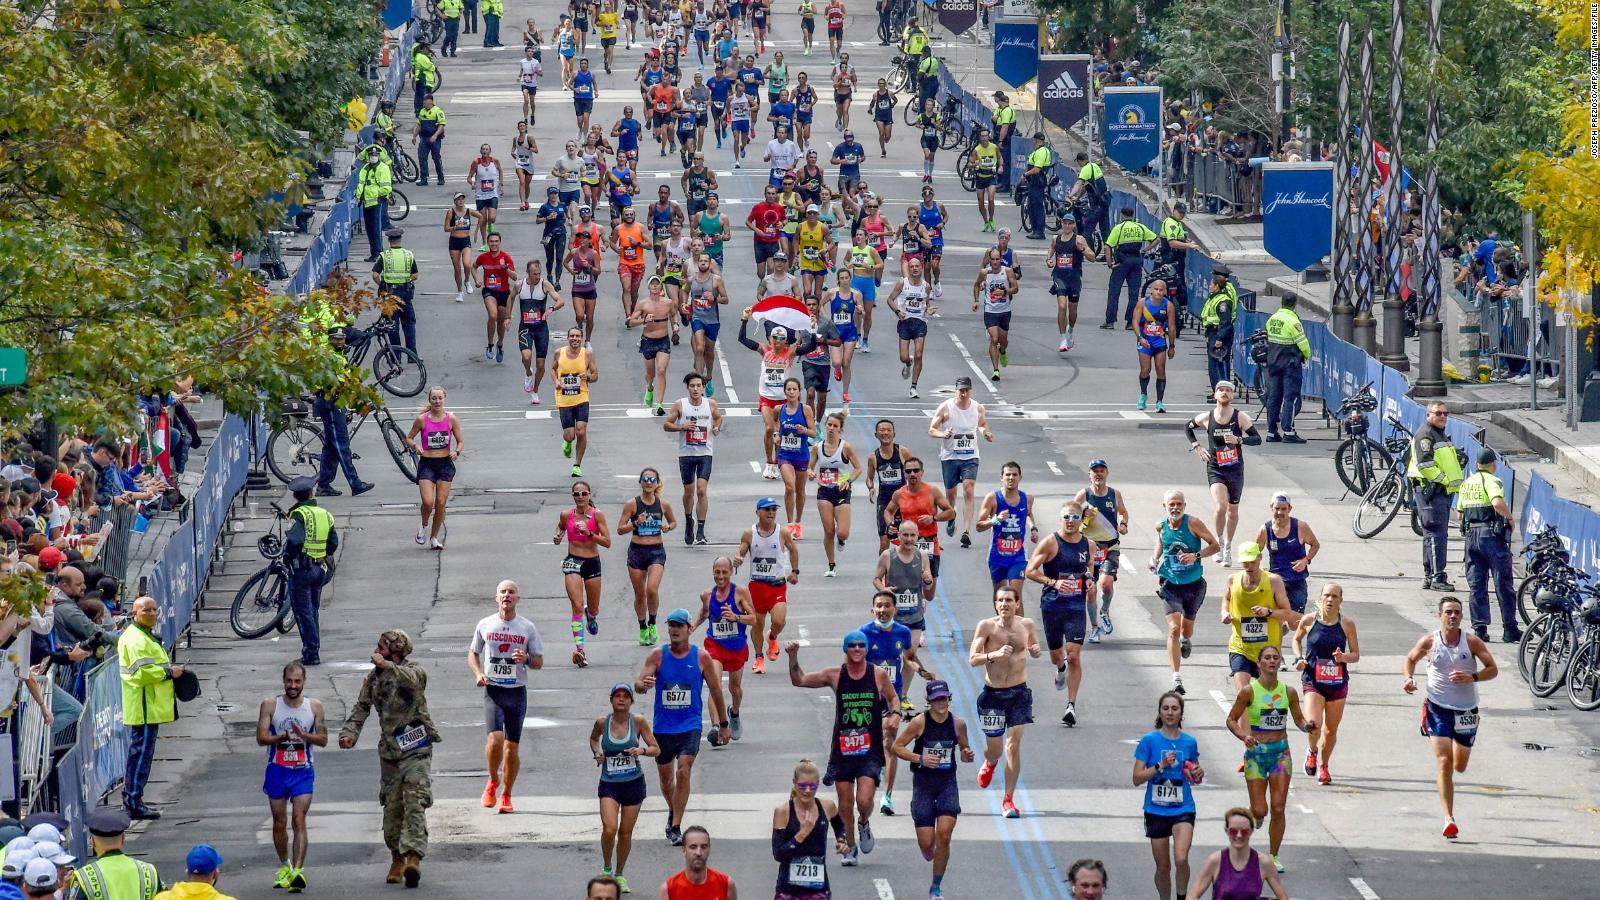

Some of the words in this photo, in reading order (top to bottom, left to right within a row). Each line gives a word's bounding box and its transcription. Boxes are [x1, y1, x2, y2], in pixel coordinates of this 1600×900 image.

[942, 2, 974, 11] adidas
[1043, 88, 1084, 98] adidas
[1265, 192, 1294, 215] John
[1292, 191, 1331, 210] Hancock
[1245, 623, 1263, 634] 4322
[486, 632, 526, 645] WISCONSIN
[493, 664, 512, 675] 4795
[666, 691, 686, 702] 6577
[1157, 785, 1178, 797] 6174
[796, 865, 818, 877] 7213
[85, 866, 103, 900] BOSTO
